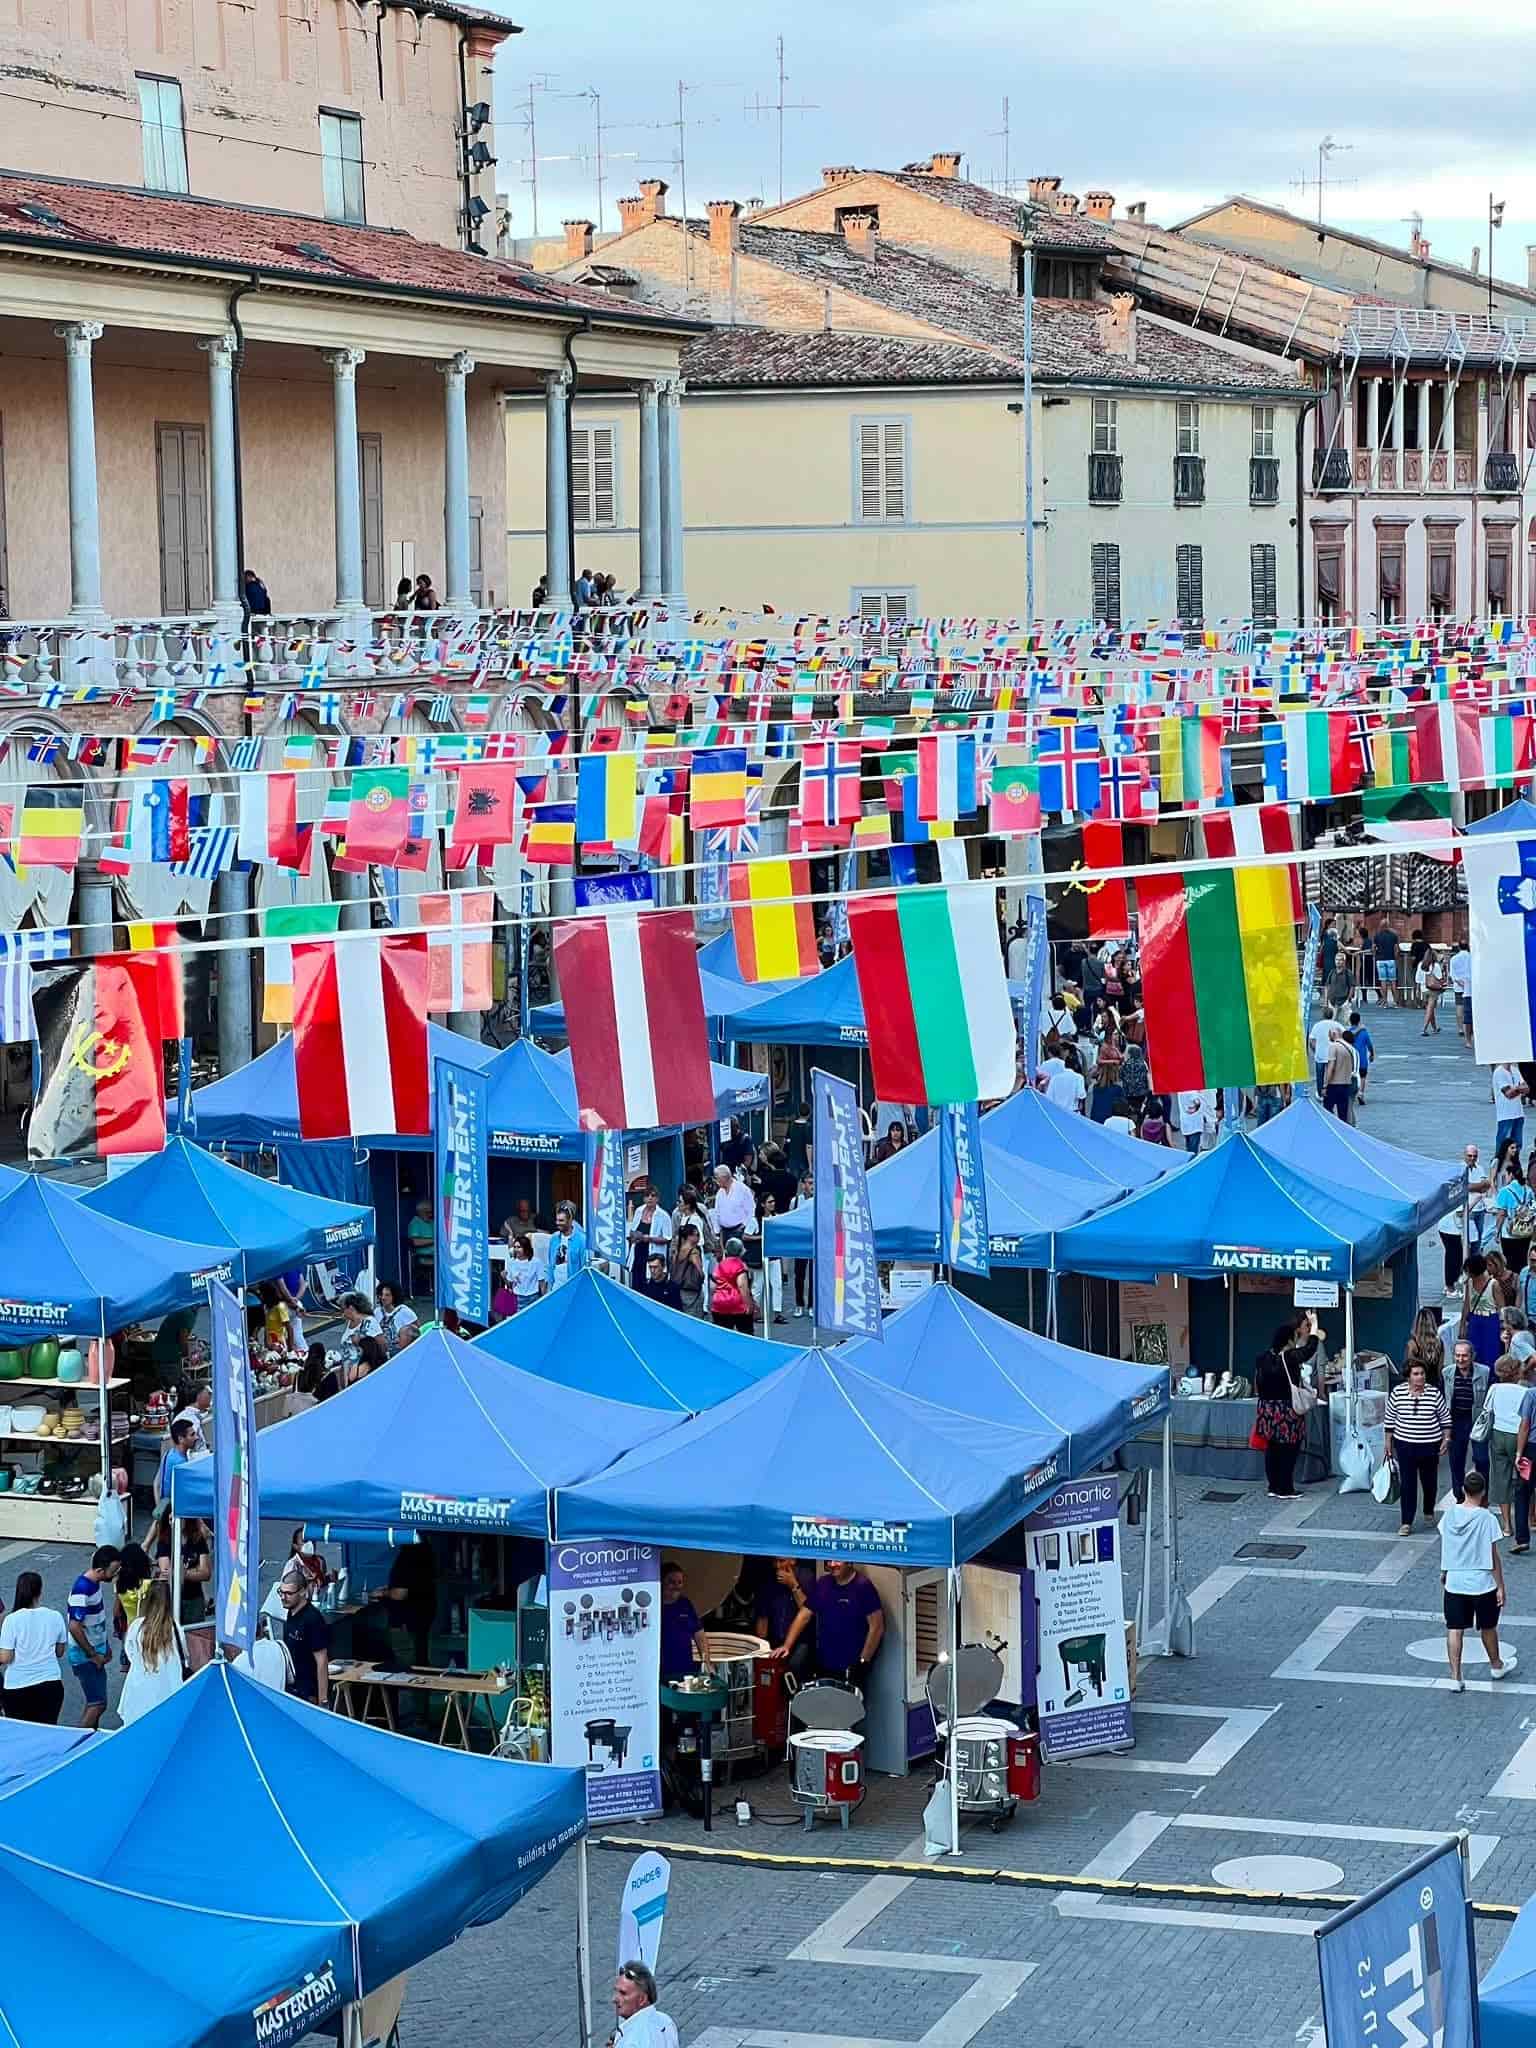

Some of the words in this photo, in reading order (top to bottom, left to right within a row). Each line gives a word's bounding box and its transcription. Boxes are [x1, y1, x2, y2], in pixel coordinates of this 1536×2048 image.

[492, 1135, 560, 1148] MASTERTENT
[449, 1082, 474, 1316] MASTERTENT
[595, 1129, 616, 1257] MASTER
[953, 1101, 979, 1269] MASTERTE
[830, 1095, 867, 1331] MASTERTENT
[470, 1228, 484, 1318] building
[0, 1303, 68, 1319] ASTERTENT
[400, 1497, 511, 1519] MASTERTENT
[1033, 1483, 1112, 1514] romartie
[400, 1511, 443, 1524] building
[447, 1517, 460, 1526] up
[464, 1518, 510, 1527] moments
[791, 1522, 908, 1544] MASTERTENT
[558, 1544, 653, 1572] Cromartie
[791, 1536, 838, 1550] building
[841, 1543, 856, 1551] up
[859, 1542, 908, 1552] moments
[517, 1841, 546, 1870] Building
[547, 1838, 557, 1852] up
[631, 1870, 656, 1891] ROHDE
[256, 1970, 337, 2041] MASTERTENT
[259, 2026, 294, 2048] building
